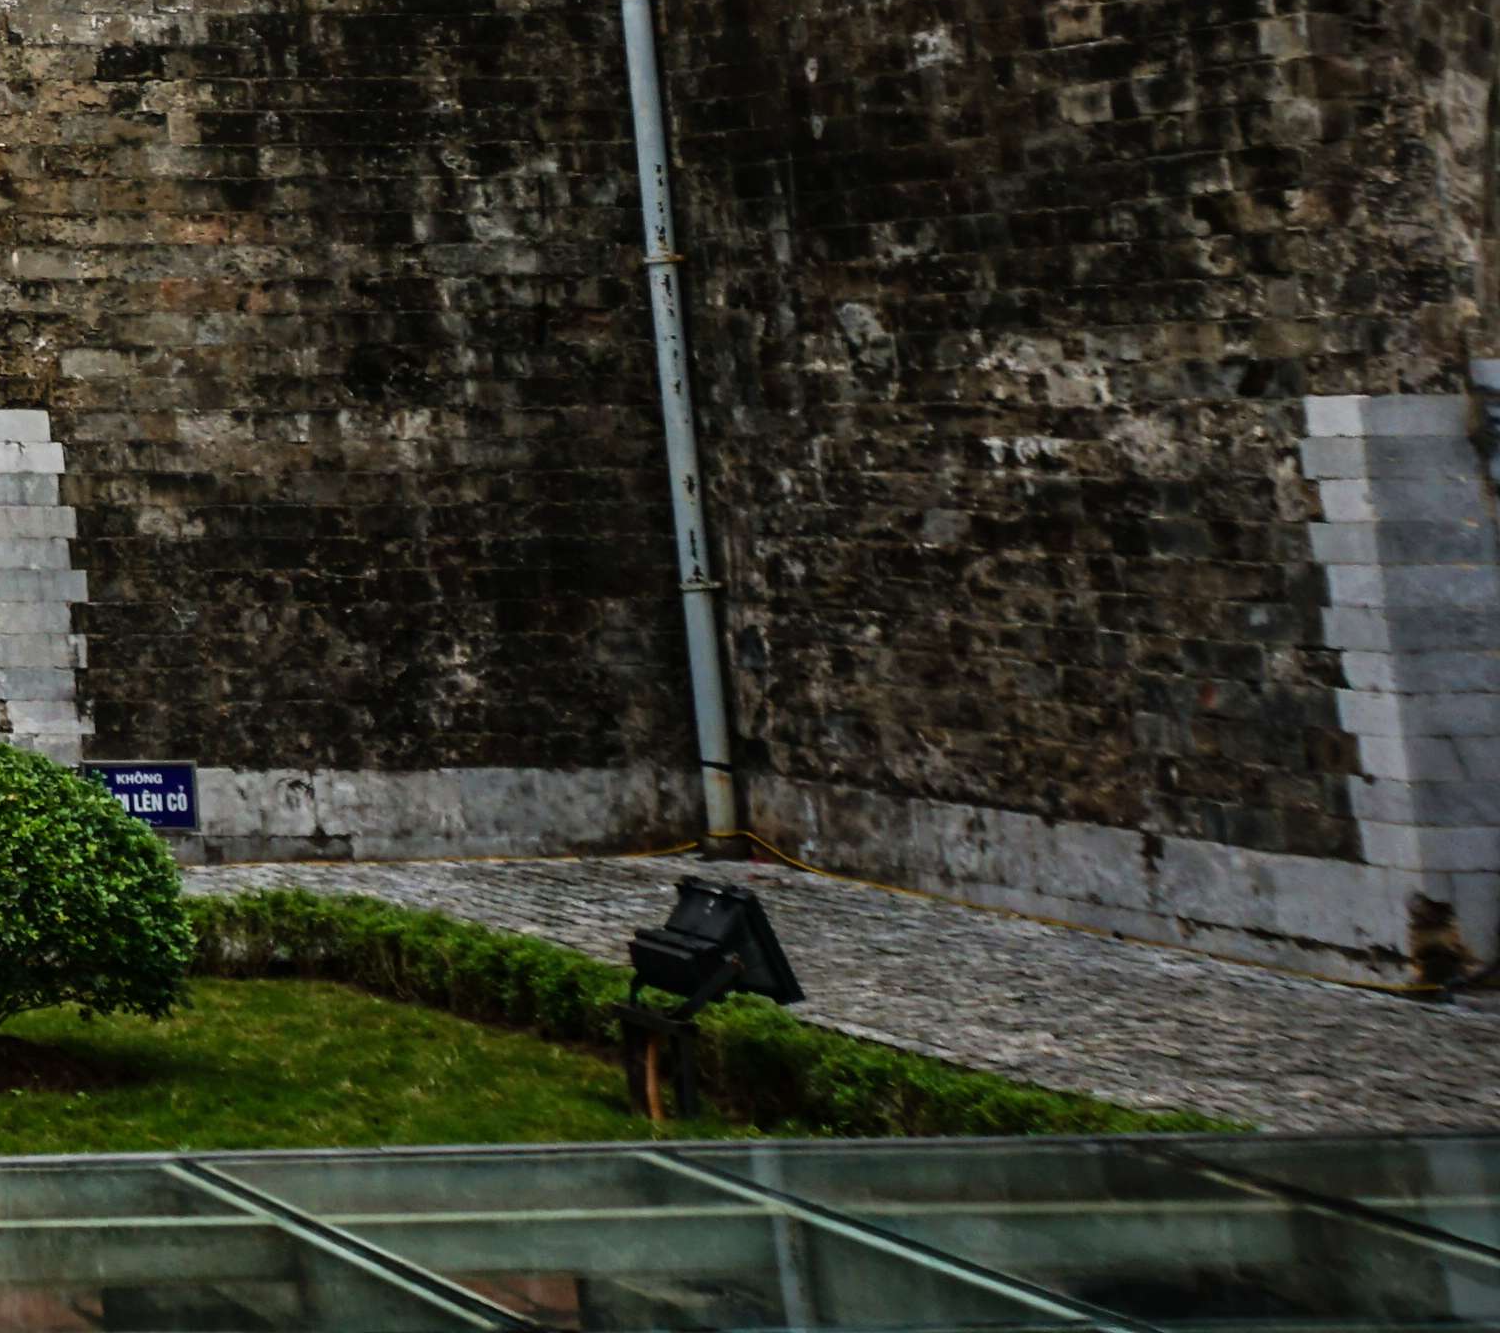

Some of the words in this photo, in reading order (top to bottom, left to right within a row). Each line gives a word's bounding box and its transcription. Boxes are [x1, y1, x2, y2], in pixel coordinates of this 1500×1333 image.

[115, 770, 163, 784] KHÔNG
[133, 789, 164, 812] LÊN
[166, 784, 188, 812] CỎ
